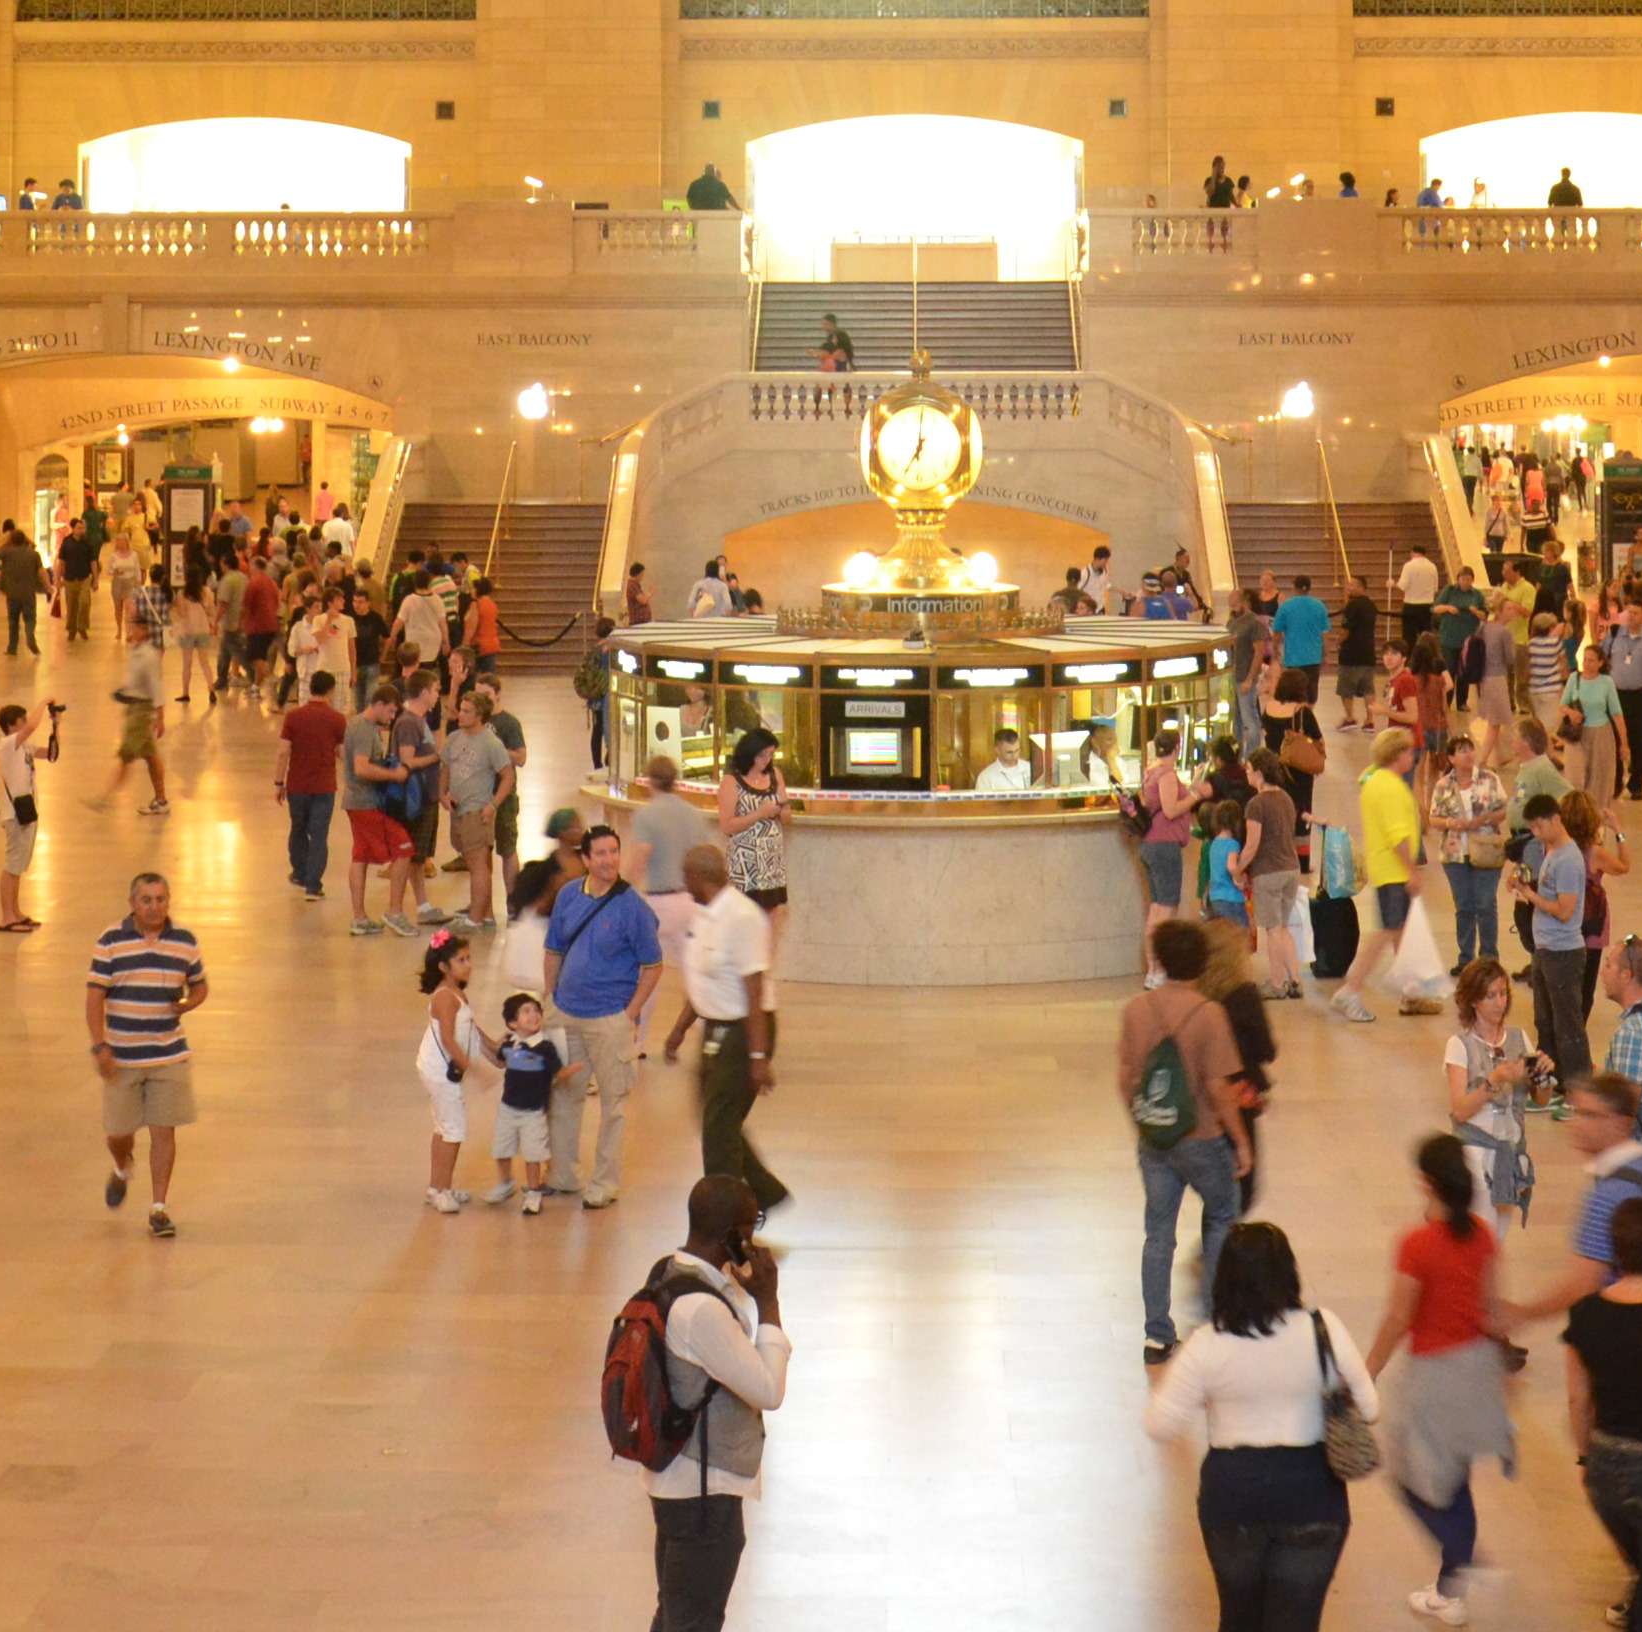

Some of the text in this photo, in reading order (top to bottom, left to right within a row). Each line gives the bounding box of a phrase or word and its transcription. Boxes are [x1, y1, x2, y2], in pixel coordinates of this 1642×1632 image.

[32, 332, 57, 350] TO
[63, 331, 79, 347] 11
[477, 333, 591, 346] EAST BALCONY
[1238, 332, 1355, 345] EAST BALCONY
[154, 330, 323, 372] LEXINGTON AVE
[1512, 331, 1637, 369] LEXINGTON
[59, 396, 389, 430] 42ND STREET PASSAGE SUBWAY 4 5 6 7
[1463, 396, 1527, 418] STREET
[1532, 393, 1606, 408] PASSAGE
[759, 494, 811, 515] TRACKS
[837, 486, 857, 497] TO
[969, 485, 1013, 500] NING
[1017, 491, 1101, 521] CONCOURSE
[887, 597, 984, 613] Information
[849, 703, 902, 713] ARRIVALS
